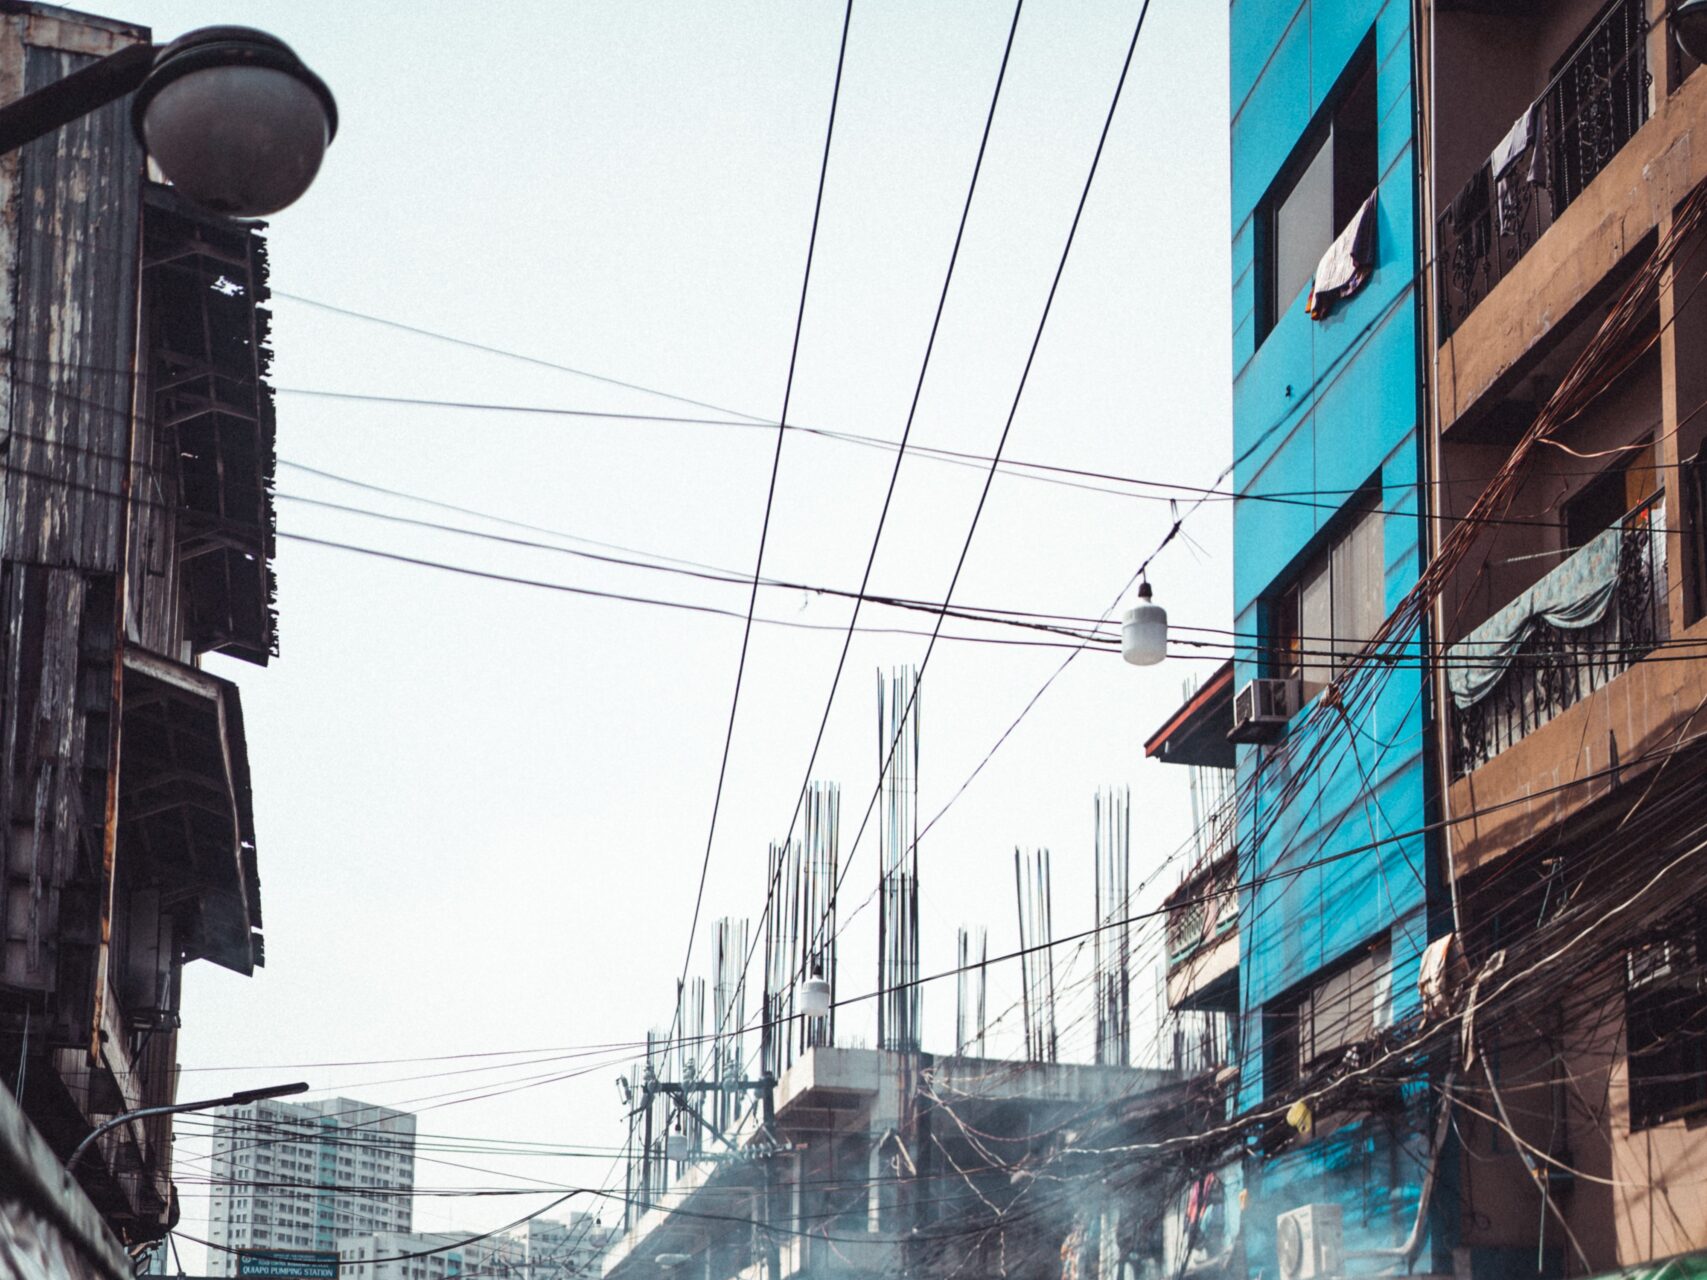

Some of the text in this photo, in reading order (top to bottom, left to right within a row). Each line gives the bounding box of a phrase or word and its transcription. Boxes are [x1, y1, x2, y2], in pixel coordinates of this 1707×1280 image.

[242, 1265, 333, 1277] QUIAPO PUMPING STATION
